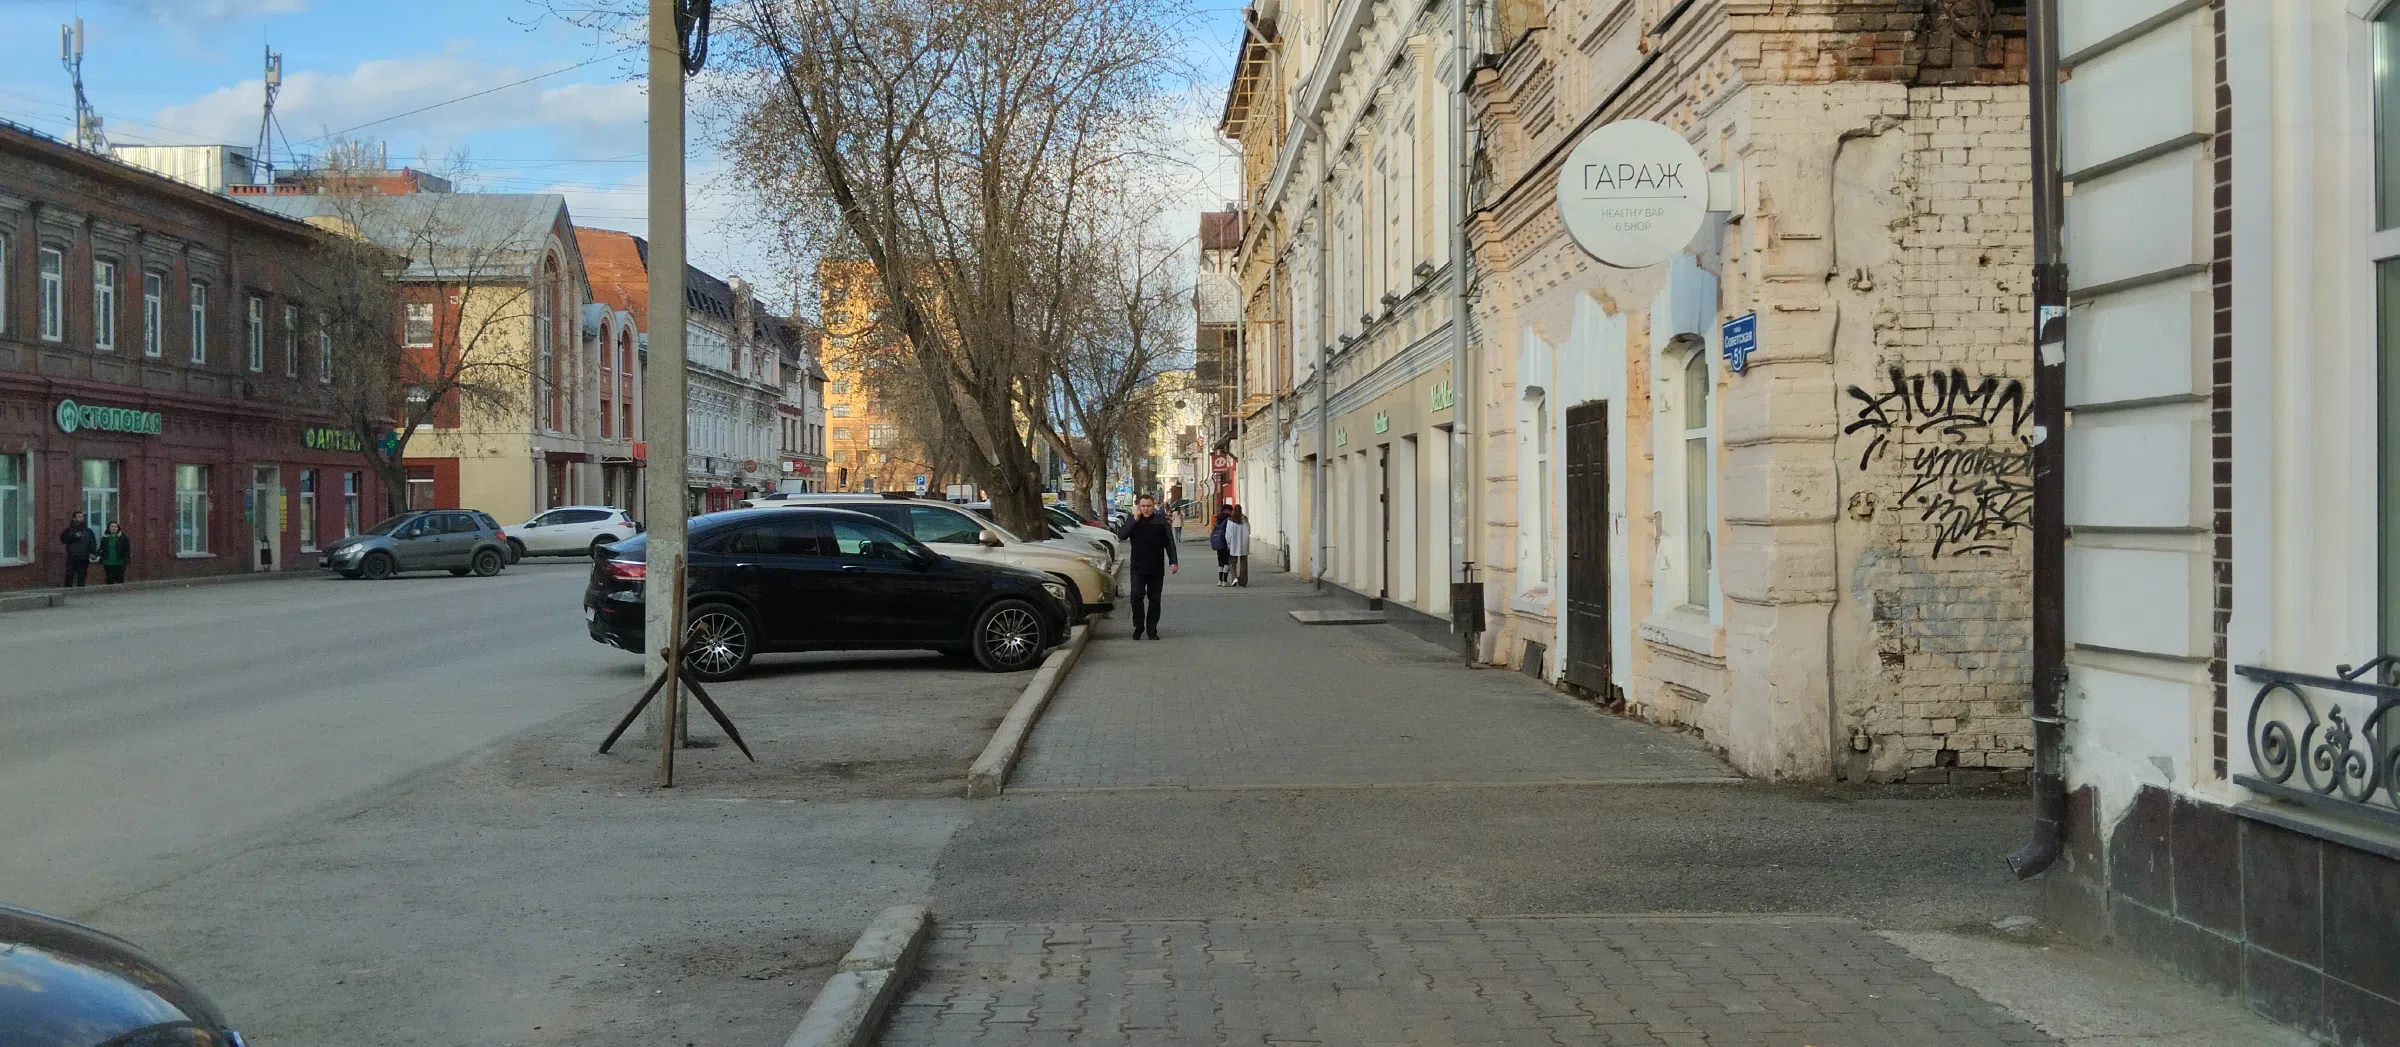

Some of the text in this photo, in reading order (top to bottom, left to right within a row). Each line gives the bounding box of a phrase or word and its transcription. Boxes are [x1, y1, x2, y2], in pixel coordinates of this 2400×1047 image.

[1584, 163, 1684, 191] ГАРАЖ
[1601, 207, 1665, 219] HEALTHY BAR
[1624, 222, 1652, 232] SHOP
[1724, 331, 1753, 349] Советская
[1733, 347, 1742, 365] 51
[79, 405, 162, 435] СТОЛОВАЯ
[316, 428, 362, 452] АПТЕК
